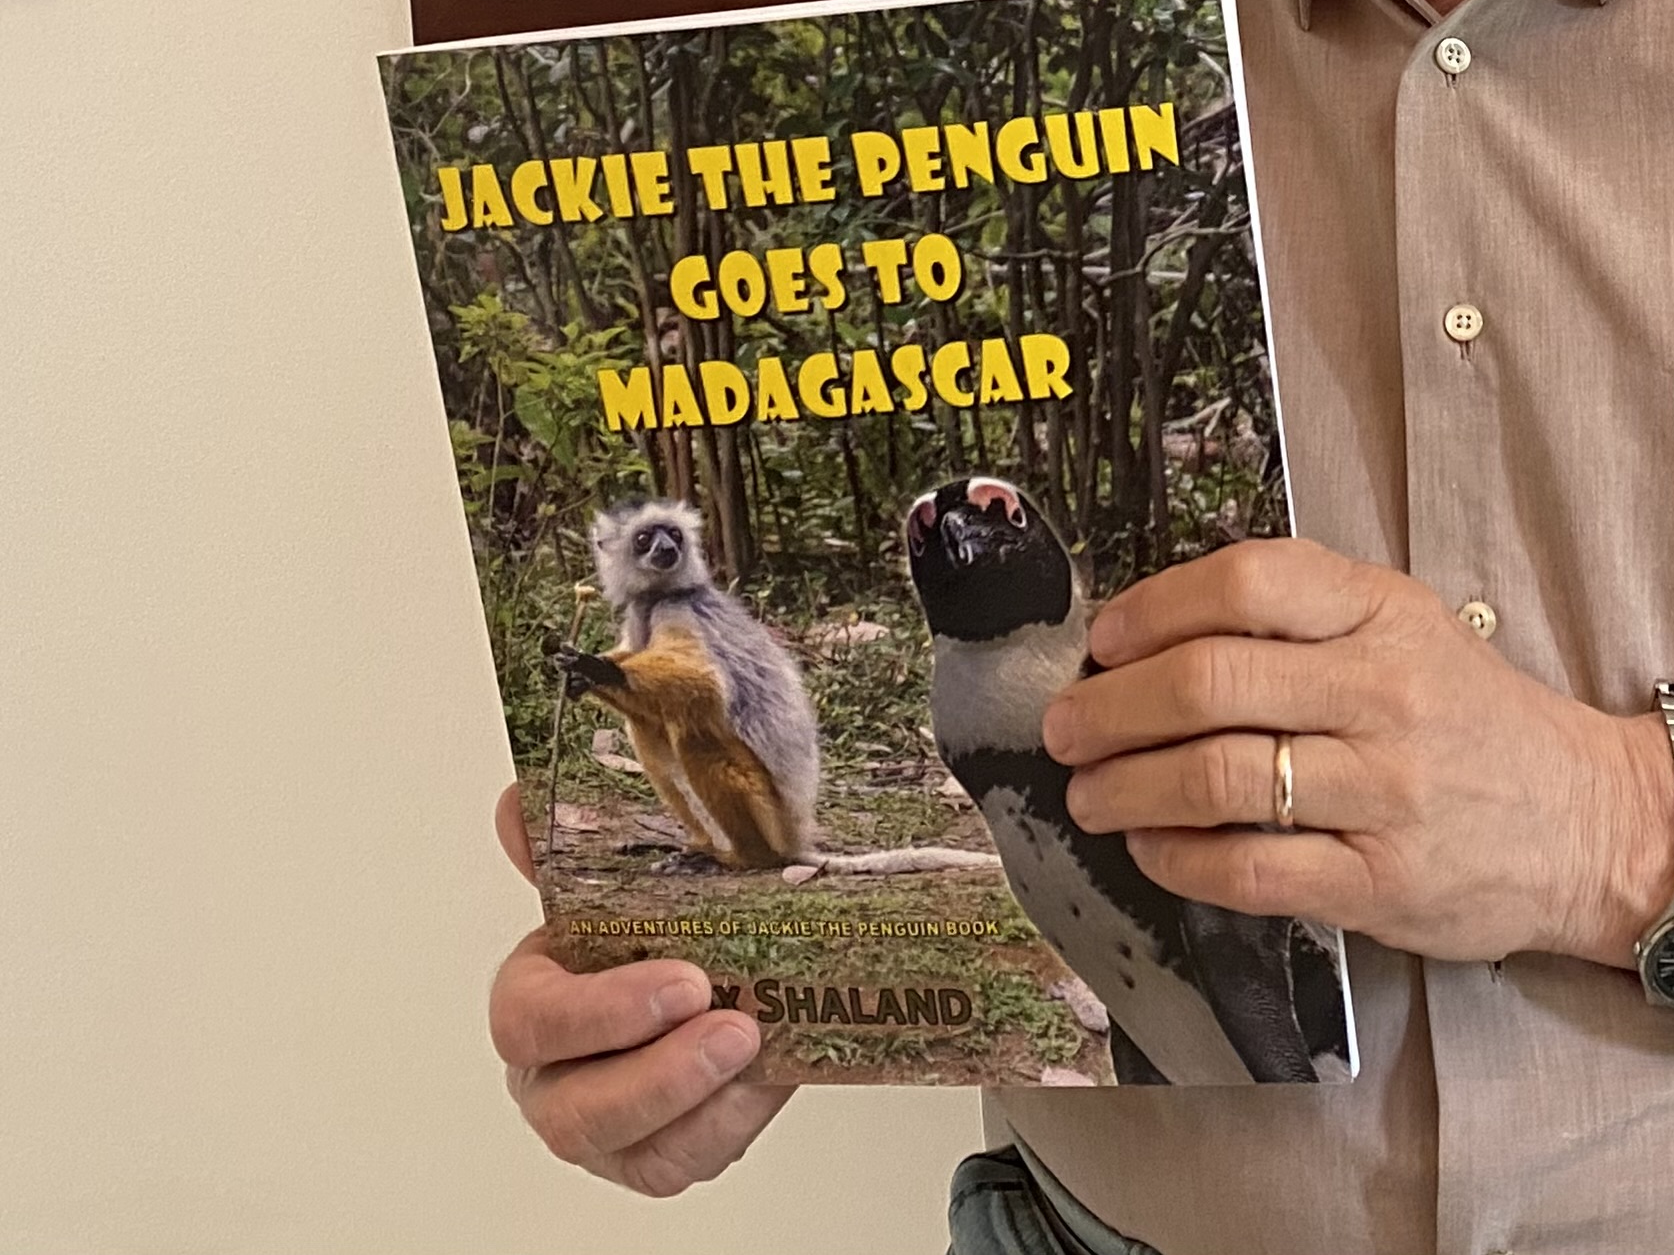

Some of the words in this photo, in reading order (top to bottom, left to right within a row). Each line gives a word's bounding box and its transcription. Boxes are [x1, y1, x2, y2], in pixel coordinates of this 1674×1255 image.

[438, 151, 674, 232] JACKIE
[687, 137, 838, 211] THE
[851, 103, 1179, 198] PENGUIN
[670, 243, 847, 321] GOES
[862, 233, 962, 305] TO
[597, 333, 1072, 432] MADAGASCAR
[570, 919, 593, 935] AN
[599, 919, 714, 935] ADVENTURES
[719, 920, 742, 935] OF
[749, 920, 812, 936] JACKIE
[817, 921, 851, 936] THE
[858, 921, 939, 936] PENGUIN
[945, 920, 999, 936] BOOK
